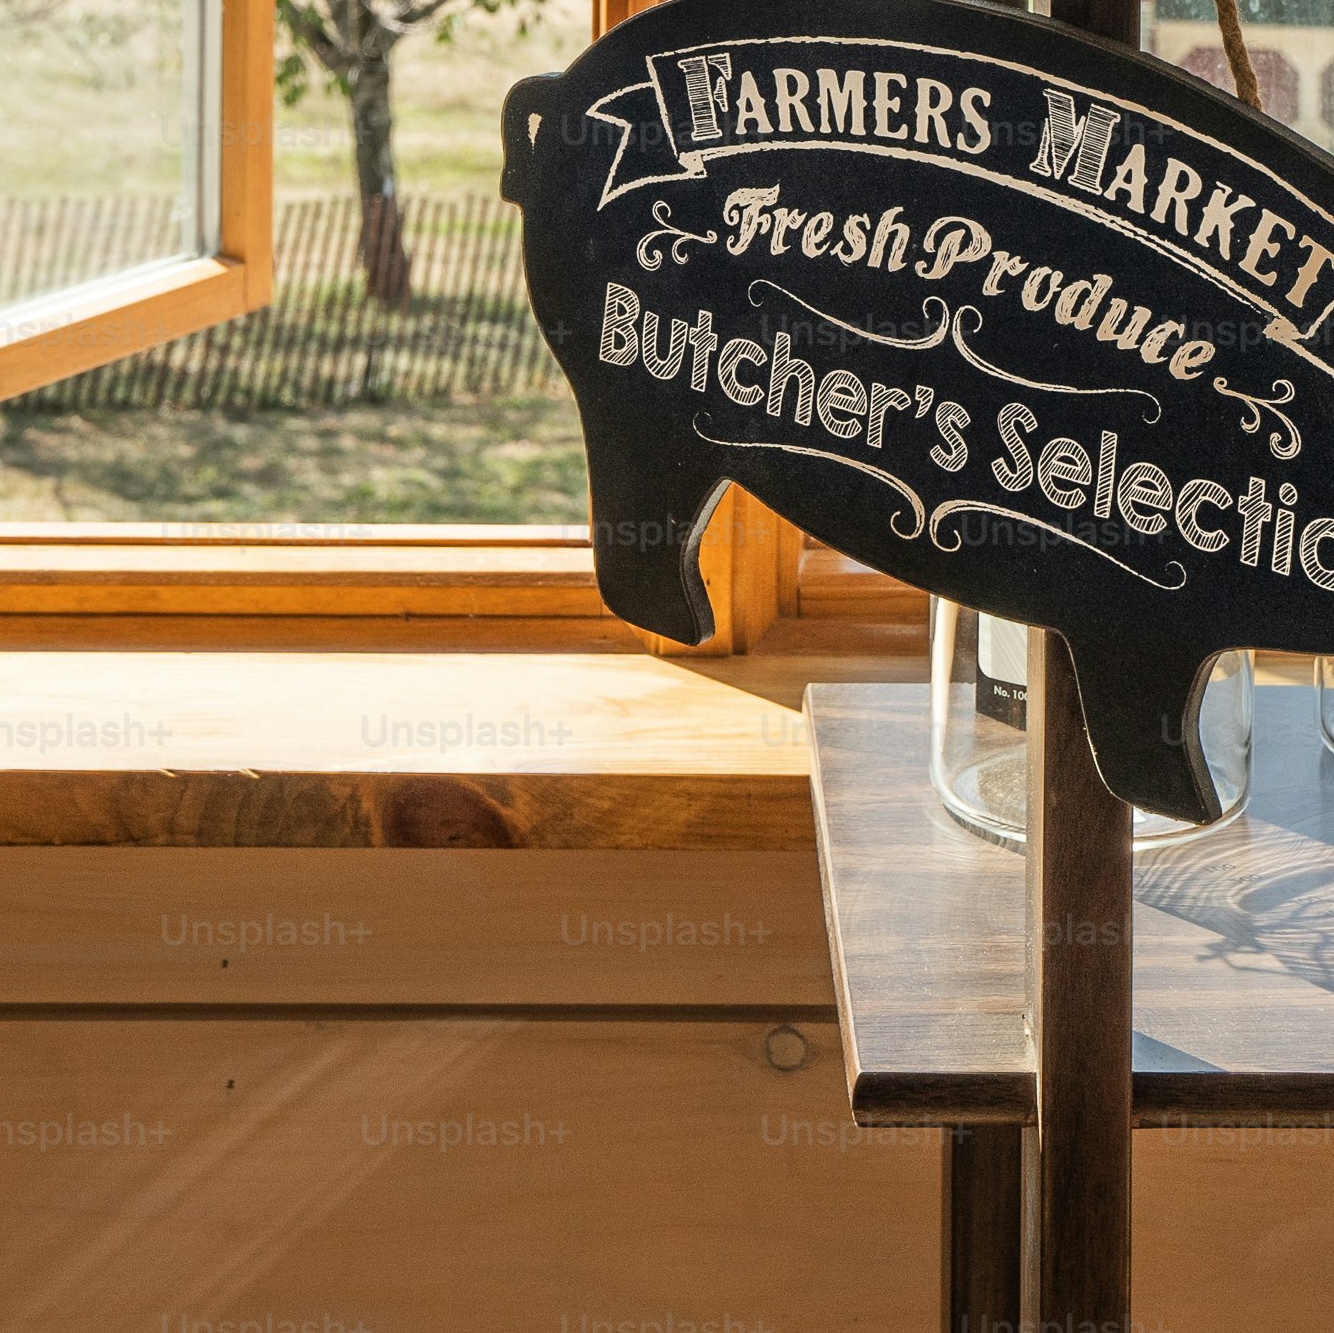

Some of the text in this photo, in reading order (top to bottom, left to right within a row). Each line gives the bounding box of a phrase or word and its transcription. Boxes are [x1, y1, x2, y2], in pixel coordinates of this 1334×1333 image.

[677, 52, 993, 155] FARMERS
[723, 184, 1216, 381] Fresh Produce
[599, 280, 971, 477] Butcher's
[993, 685, 1010, 698] No.
